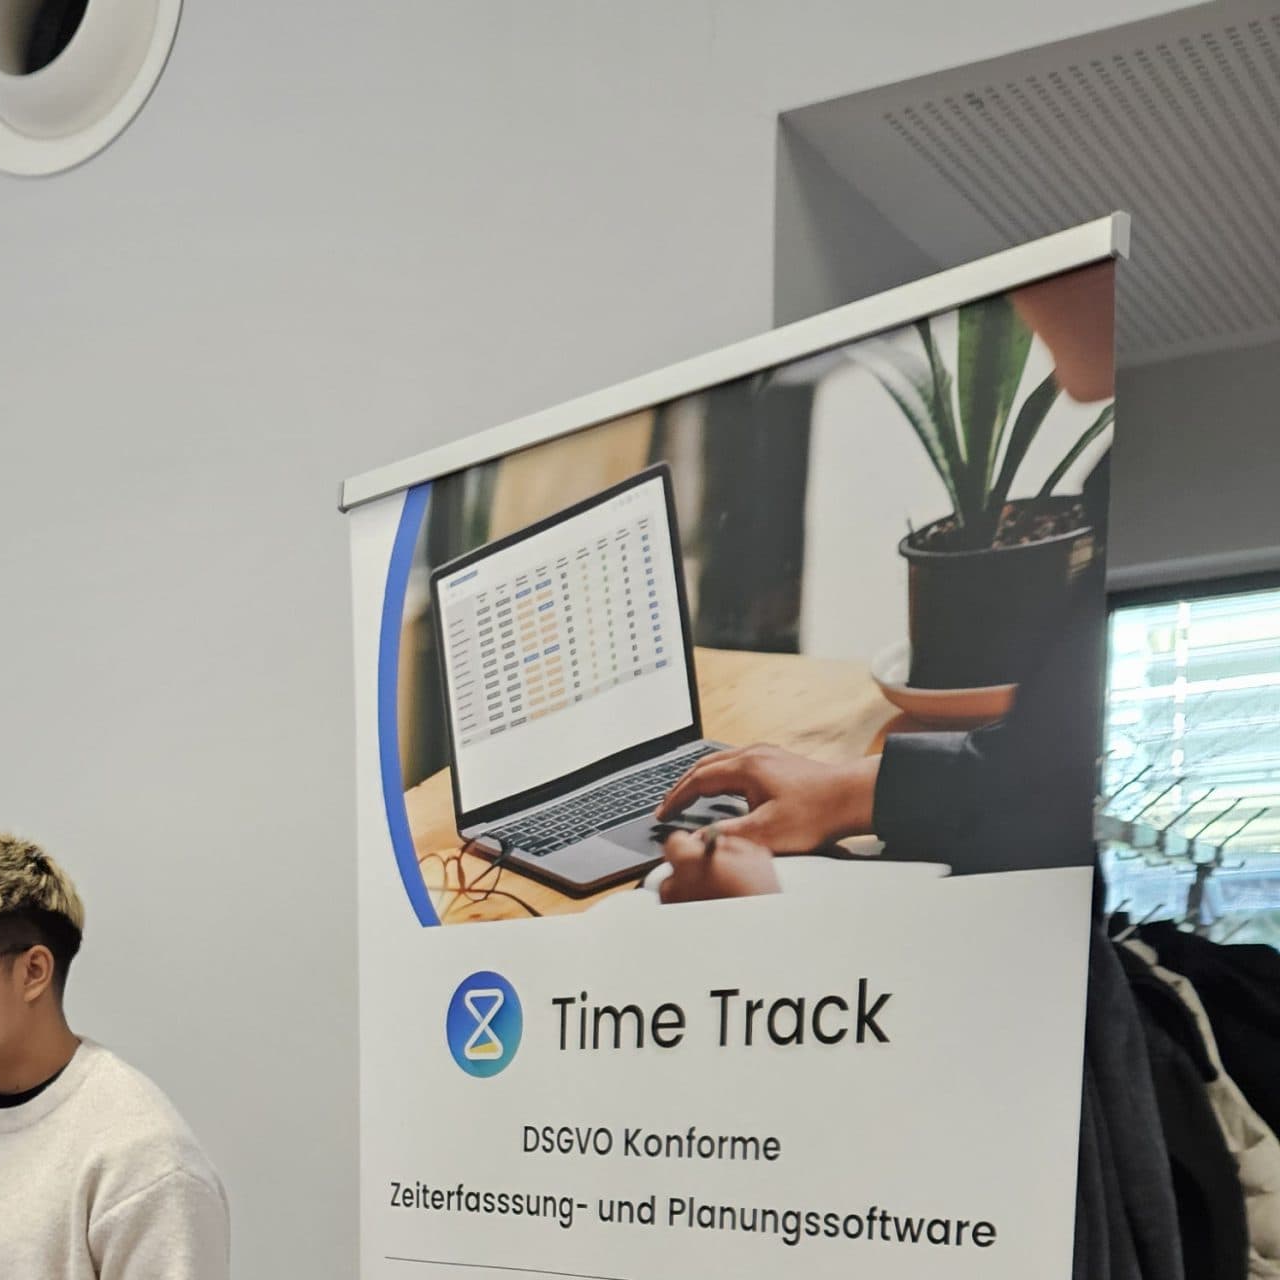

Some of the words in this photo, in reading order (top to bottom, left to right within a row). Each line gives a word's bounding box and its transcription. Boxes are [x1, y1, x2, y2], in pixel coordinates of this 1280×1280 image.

[552, 991, 686, 1050] Time
[709, 978, 893, 1047] Track
[522, 1124, 613, 1156] DSGVO
[623, 1126, 782, 1161] Konforme
[389, 1182, 589, 1229] Zeiterfasssung-
[597, 1195, 656, 1226] und
[667, 1198, 998, 1248] Planungssoftware
